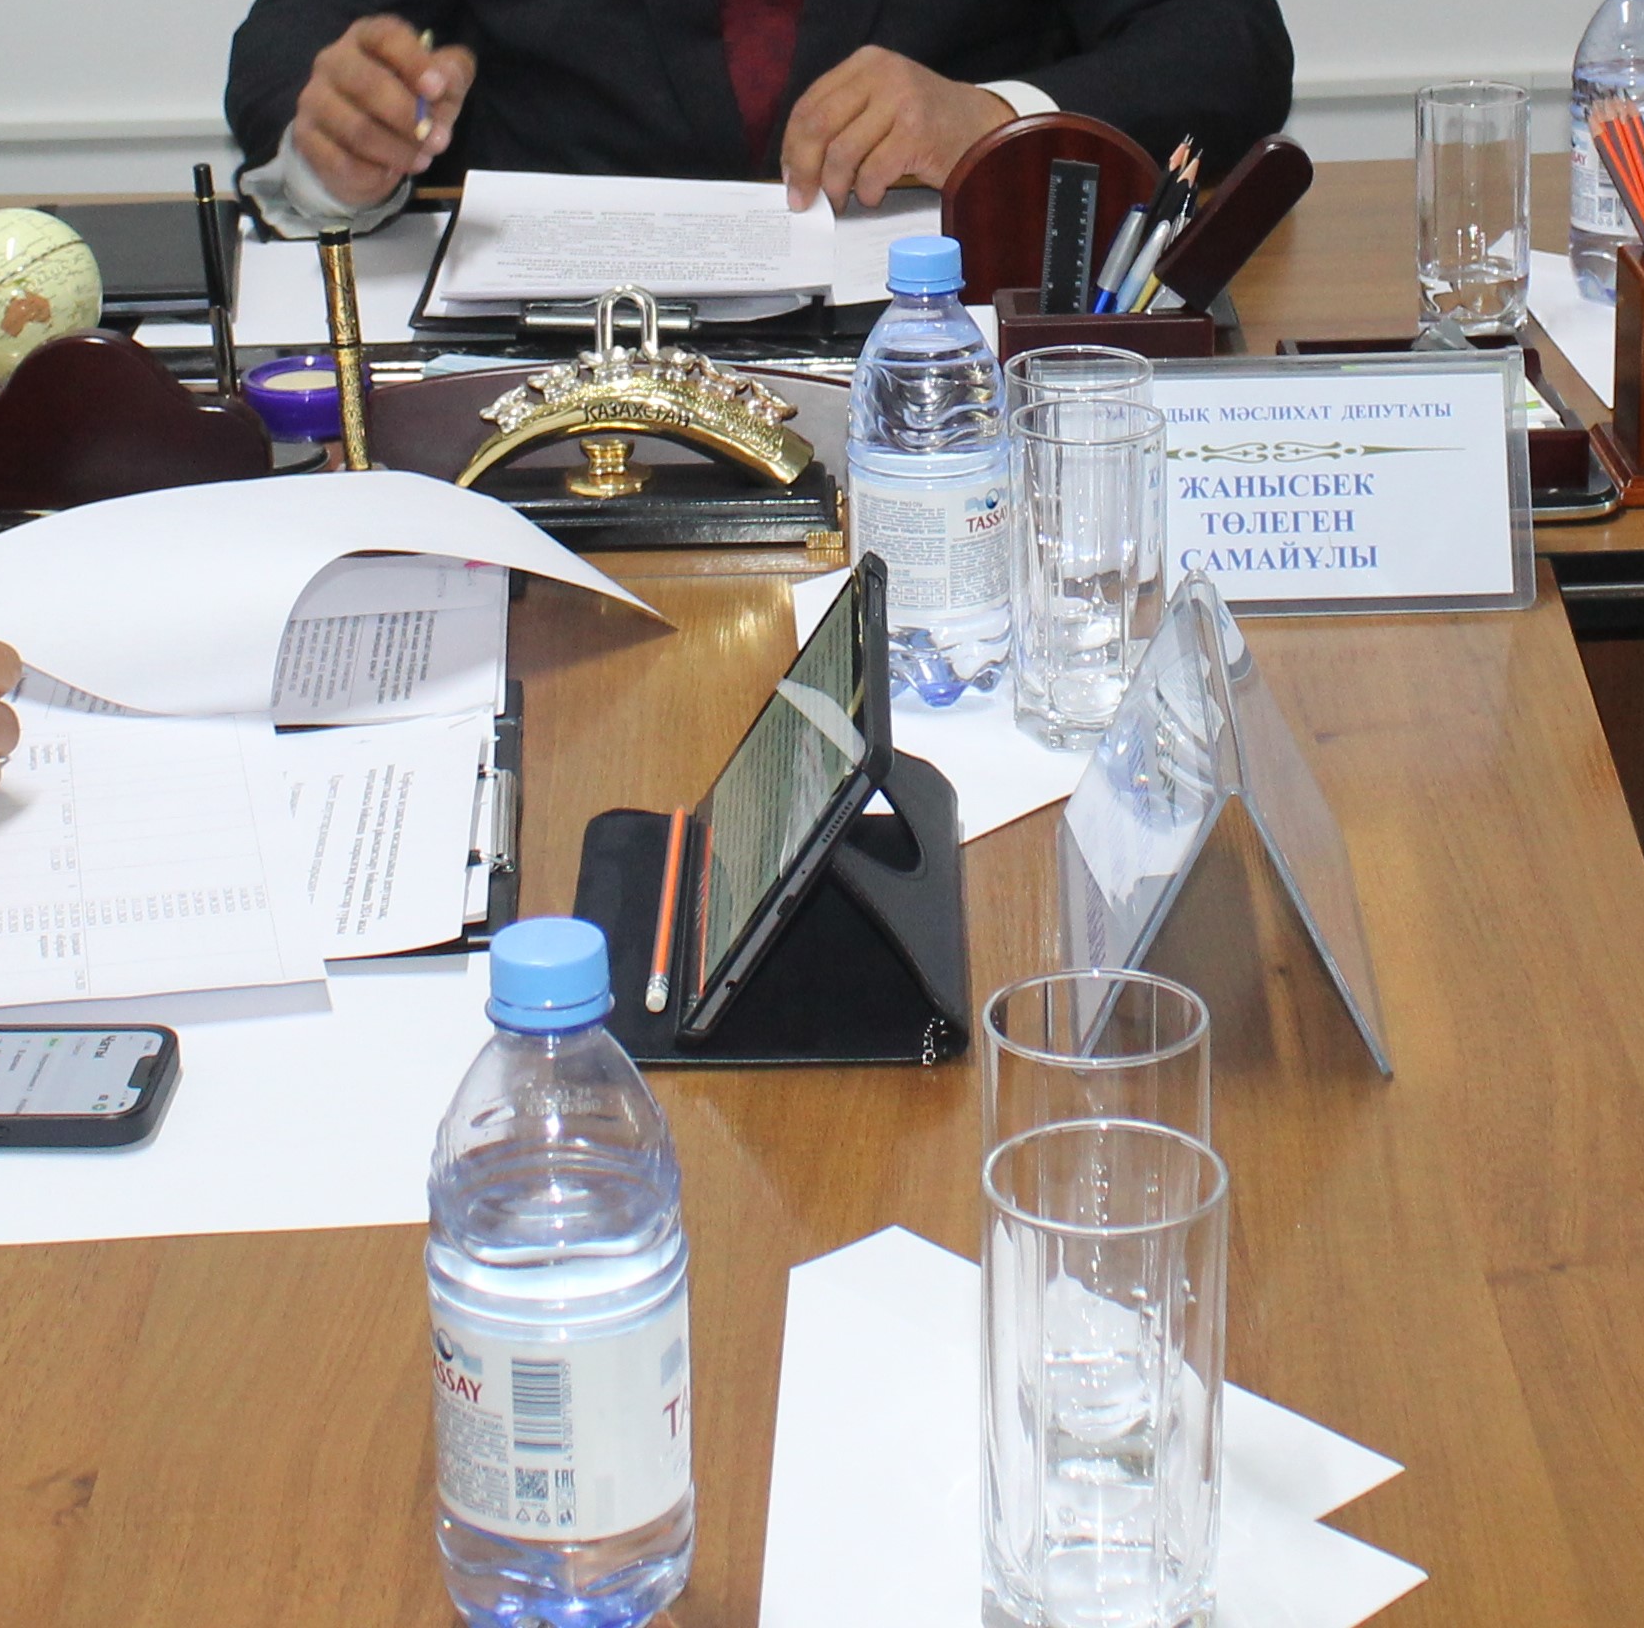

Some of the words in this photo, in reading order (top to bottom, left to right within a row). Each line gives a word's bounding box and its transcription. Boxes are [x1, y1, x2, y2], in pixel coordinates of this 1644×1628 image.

[1219, 405, 1332, 422] МӘСЛИХАТ
[1341, 403, 1452, 421] ДЕПУТАТЫ
[1179, 473, 1375, 500] ЖАНЫСБЕК
[965, 506, 1007, 533] TASSA
[1201, 509, 1355, 535] ТӨЛЕГЕН
[1179, 541, 1378, 572] САМАЙҰЛЫ
[432, 1352, 482, 1404] ASSAY
